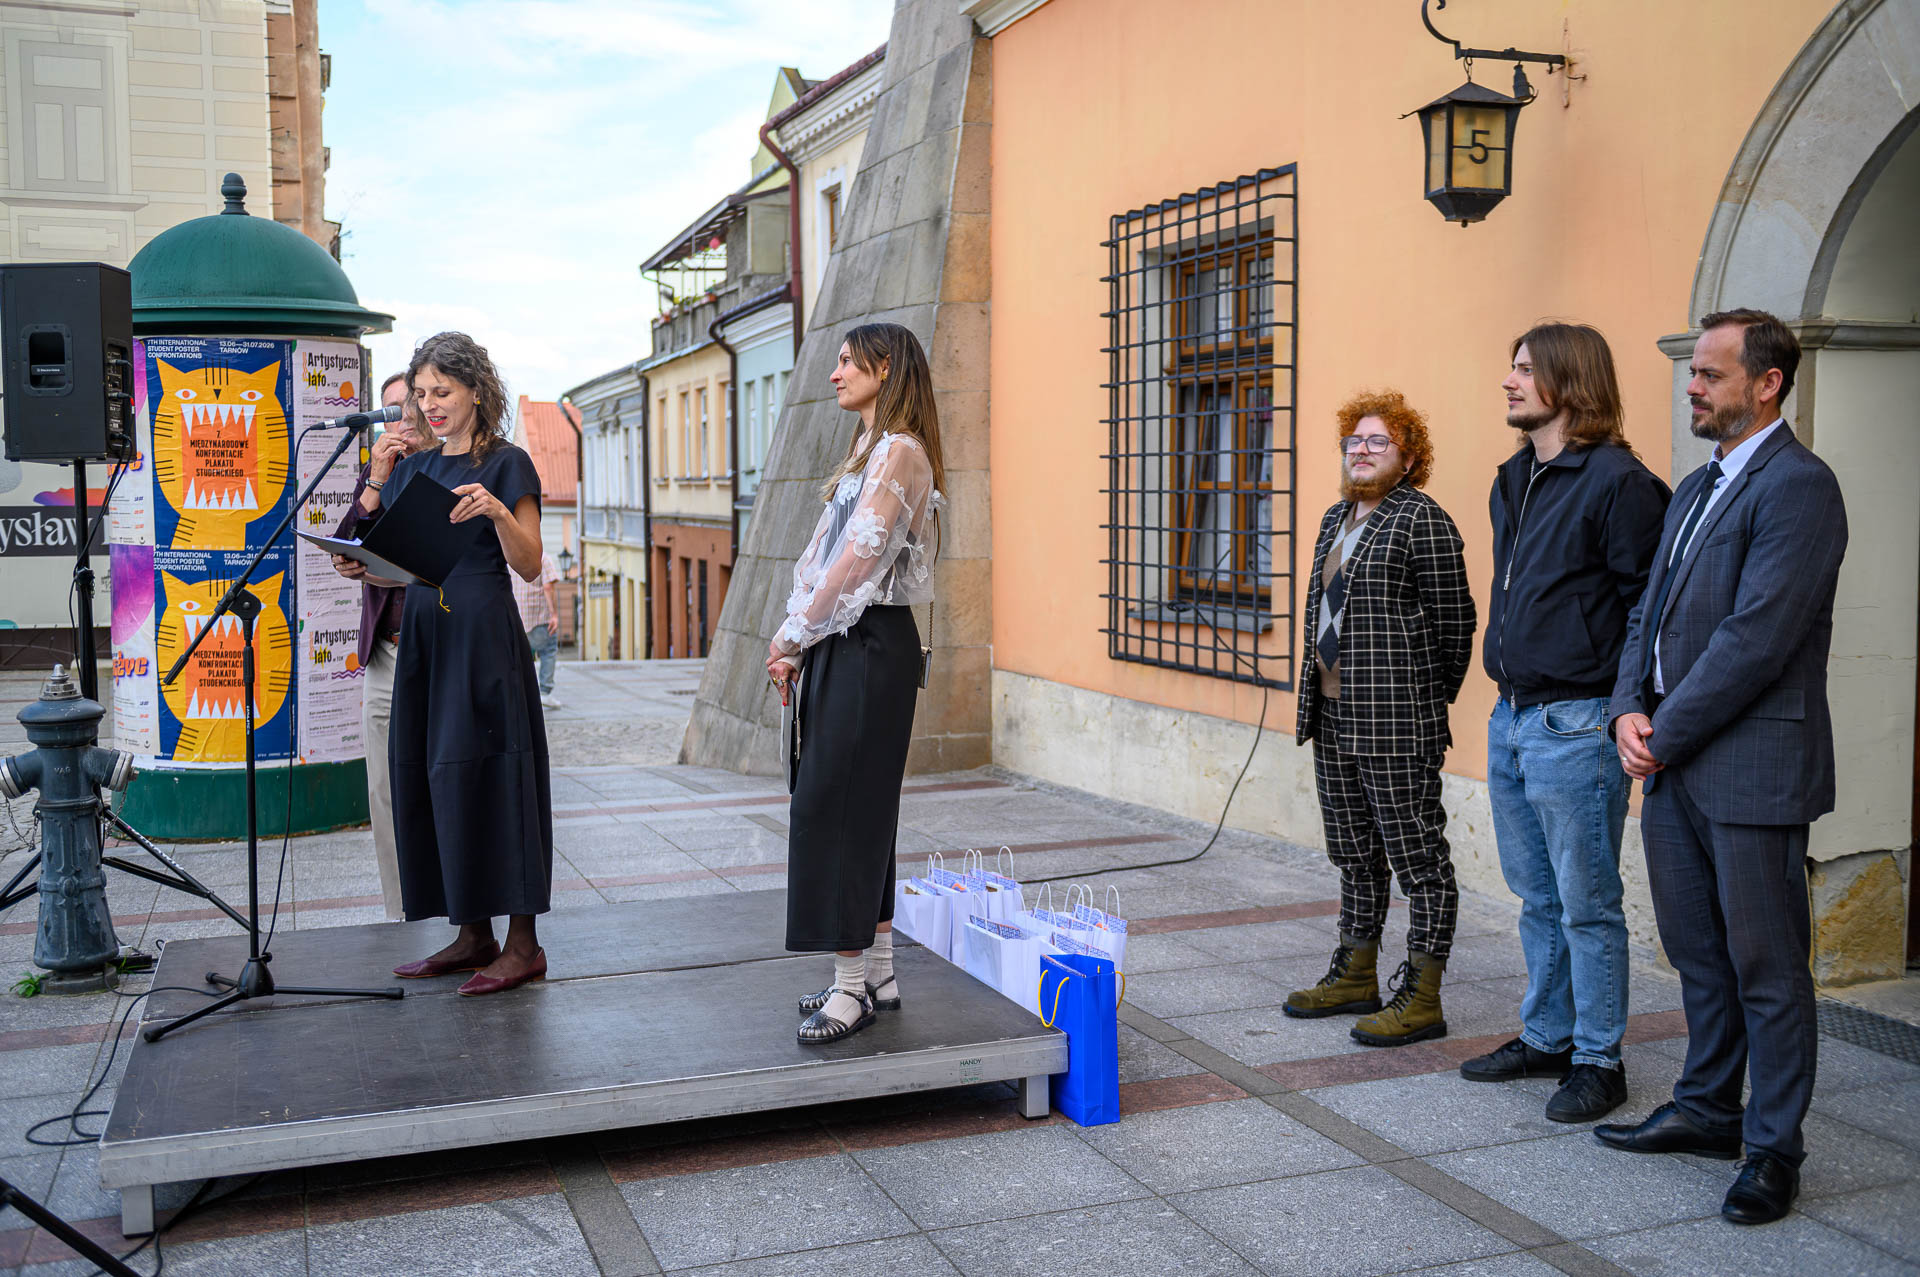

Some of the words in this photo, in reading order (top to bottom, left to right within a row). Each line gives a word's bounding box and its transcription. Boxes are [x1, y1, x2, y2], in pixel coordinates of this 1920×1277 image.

[1469, 129, 1490, 164] 5
[308, 352, 359, 371] Artystyczne
[190, 439, 248, 449] MIĘDZYNARODOWE
[195, 449, 243, 458] KONFRONTACJE
[205, 459, 234, 467] PLAKATU
[196, 469, 244, 477] STUDENCKIEGO
[309, 491, 354, 507] Artystyczn
[314, 629, 360, 646] Artystyczn
[193, 650, 244, 659] MIĘDZYNARODO
[198, 659, 243, 668] KONFRONTACJ
[208, 669, 236, 677] PLAKATU
[960, 1058, 981, 1066] HANDY
